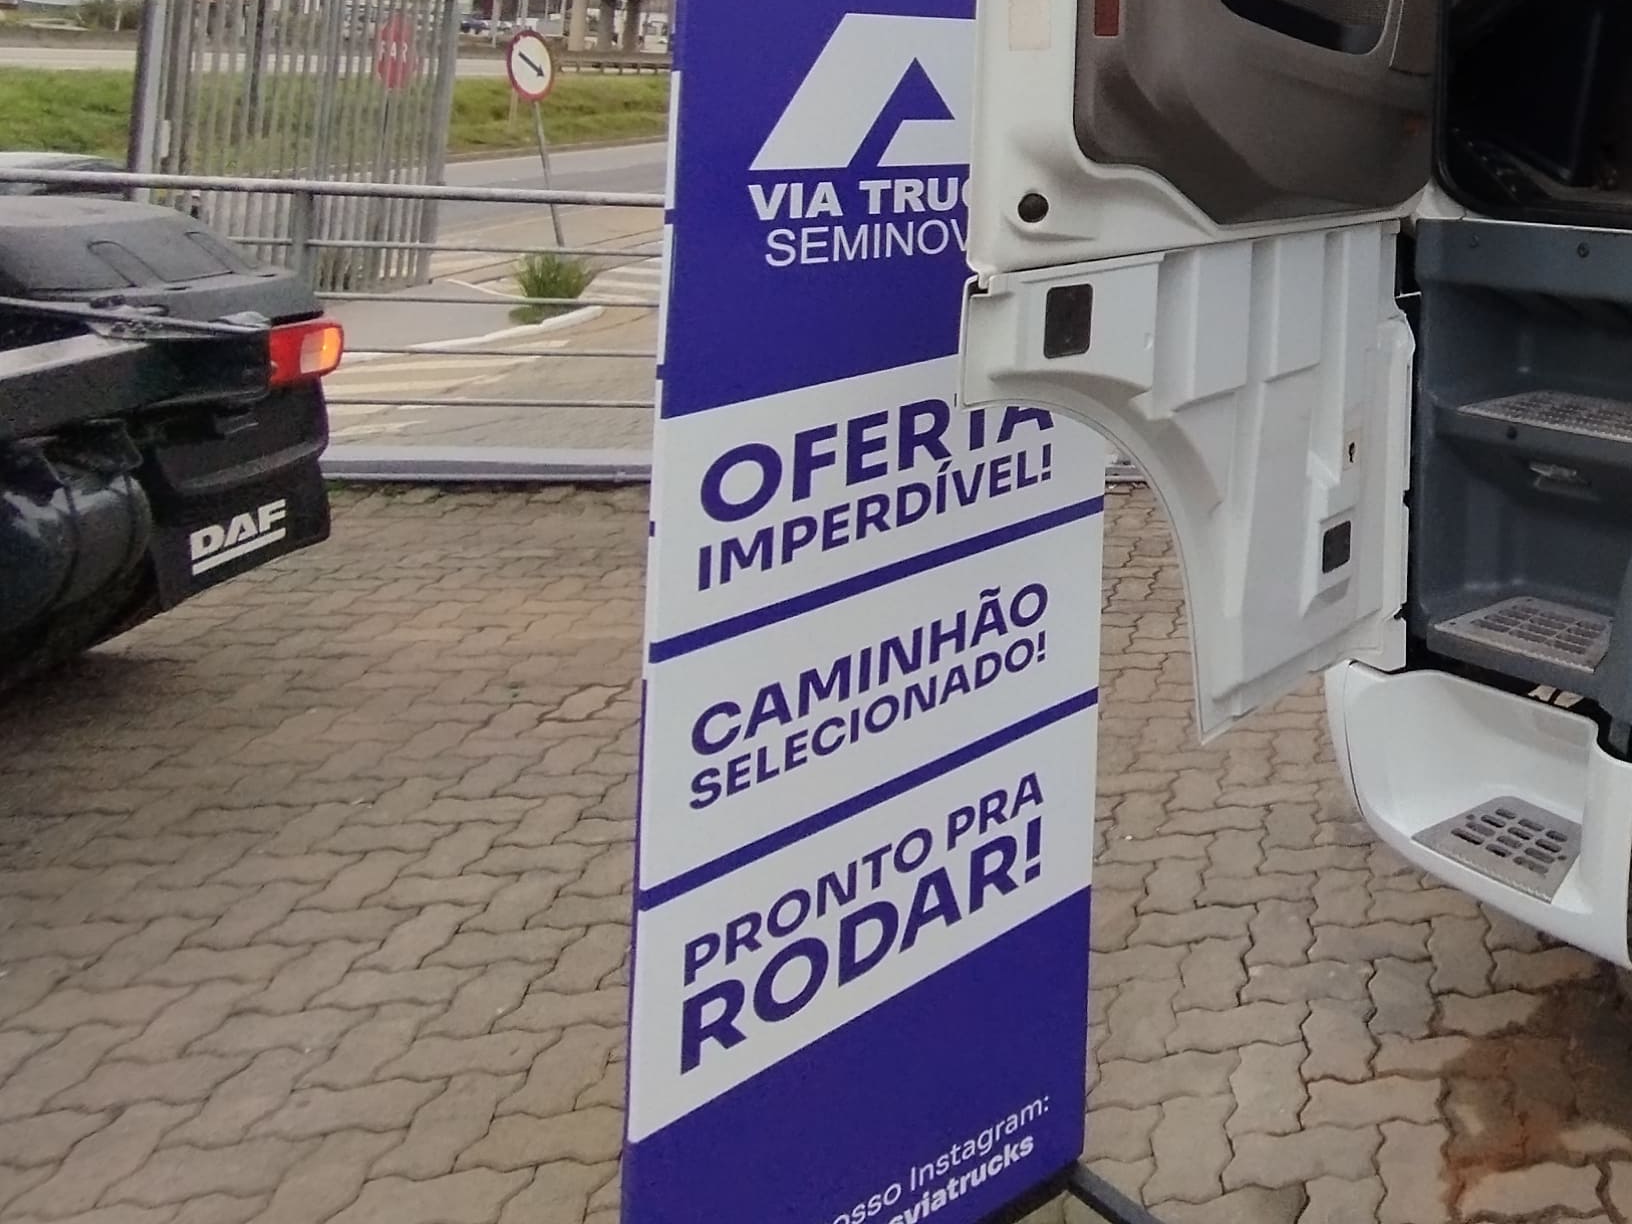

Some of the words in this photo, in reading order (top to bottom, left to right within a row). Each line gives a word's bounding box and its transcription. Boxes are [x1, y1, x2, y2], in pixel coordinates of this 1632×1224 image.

[748, 181, 844, 221] VIA
[858, 176, 970, 215] TRU
[189, 498, 287, 561] DAF
[697, 443, 1052, 592] IMPERDÍVEL!
[688, 630, 1046, 811] SELECIONADO!
[690, 583, 1049, 756] CAMINHÃO
[680, 815, 1042, 1076] RODAR!
[683, 828, 933, 987] PRONTO
[946, 771, 1044, 852] PRA
[909, 1095, 1050, 1191] Instagram:
